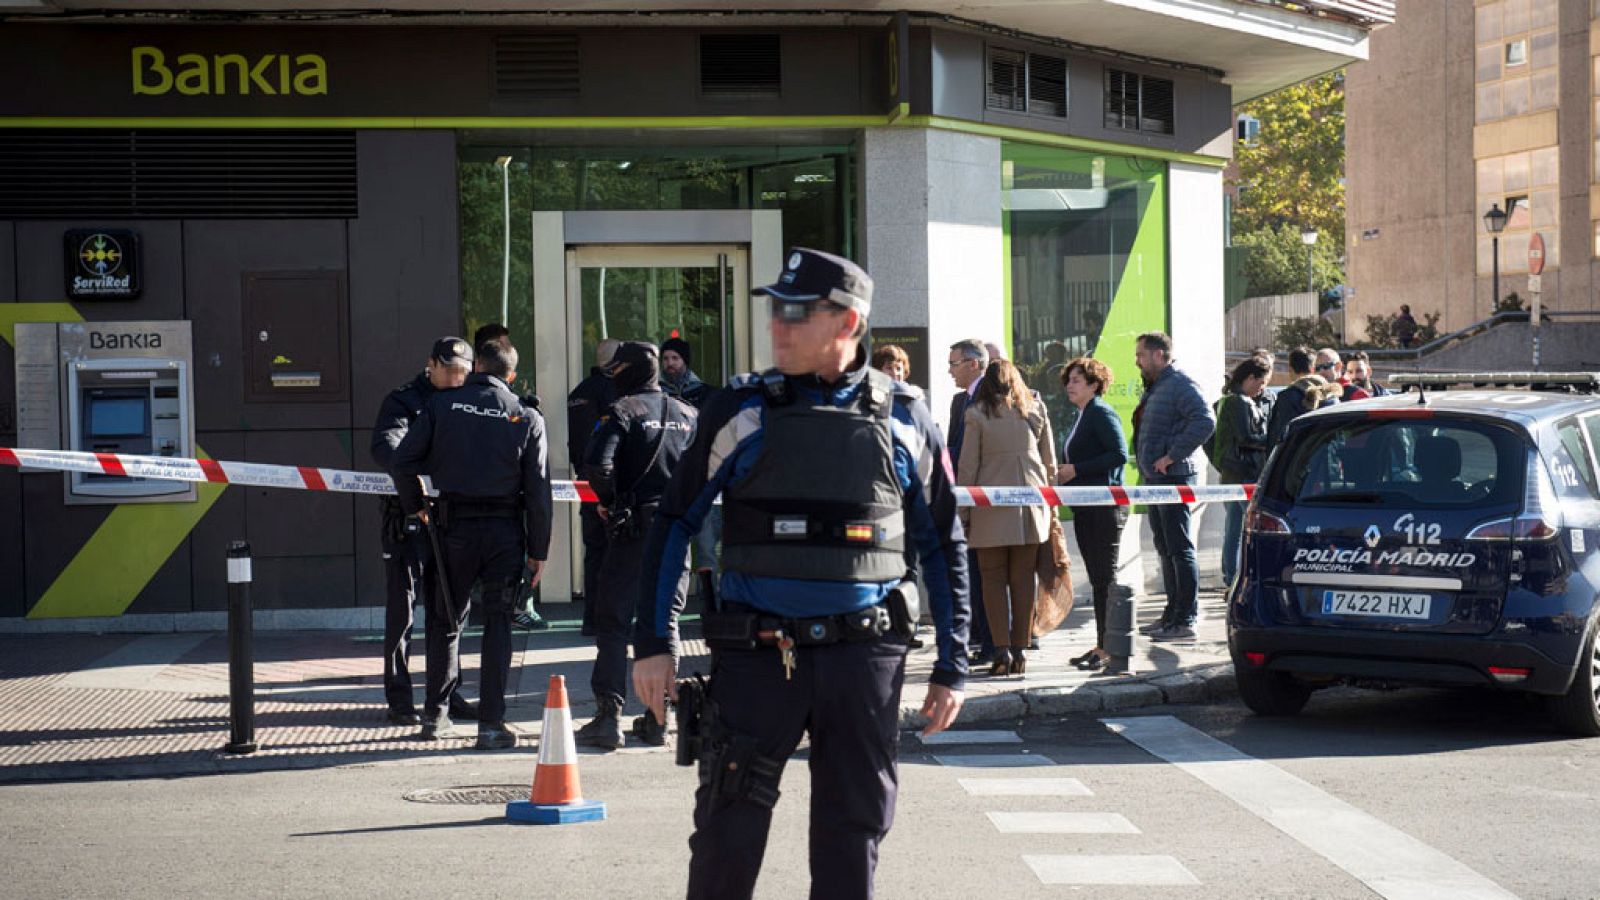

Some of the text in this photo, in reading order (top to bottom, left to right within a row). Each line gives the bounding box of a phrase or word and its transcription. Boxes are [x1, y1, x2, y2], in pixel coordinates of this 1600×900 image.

[132, 47, 328, 95] Bankia
[74, 274, 130, 289] ServiRed
[90, 331, 162, 349] Bankia
[1404, 523, 1442, 545] 112
[1294, 563, 1354, 572] MUNICIPAL
[1376, 551, 1476, 567] MADRID
[1335, 593, 1426, 615] 7422 HXJ
